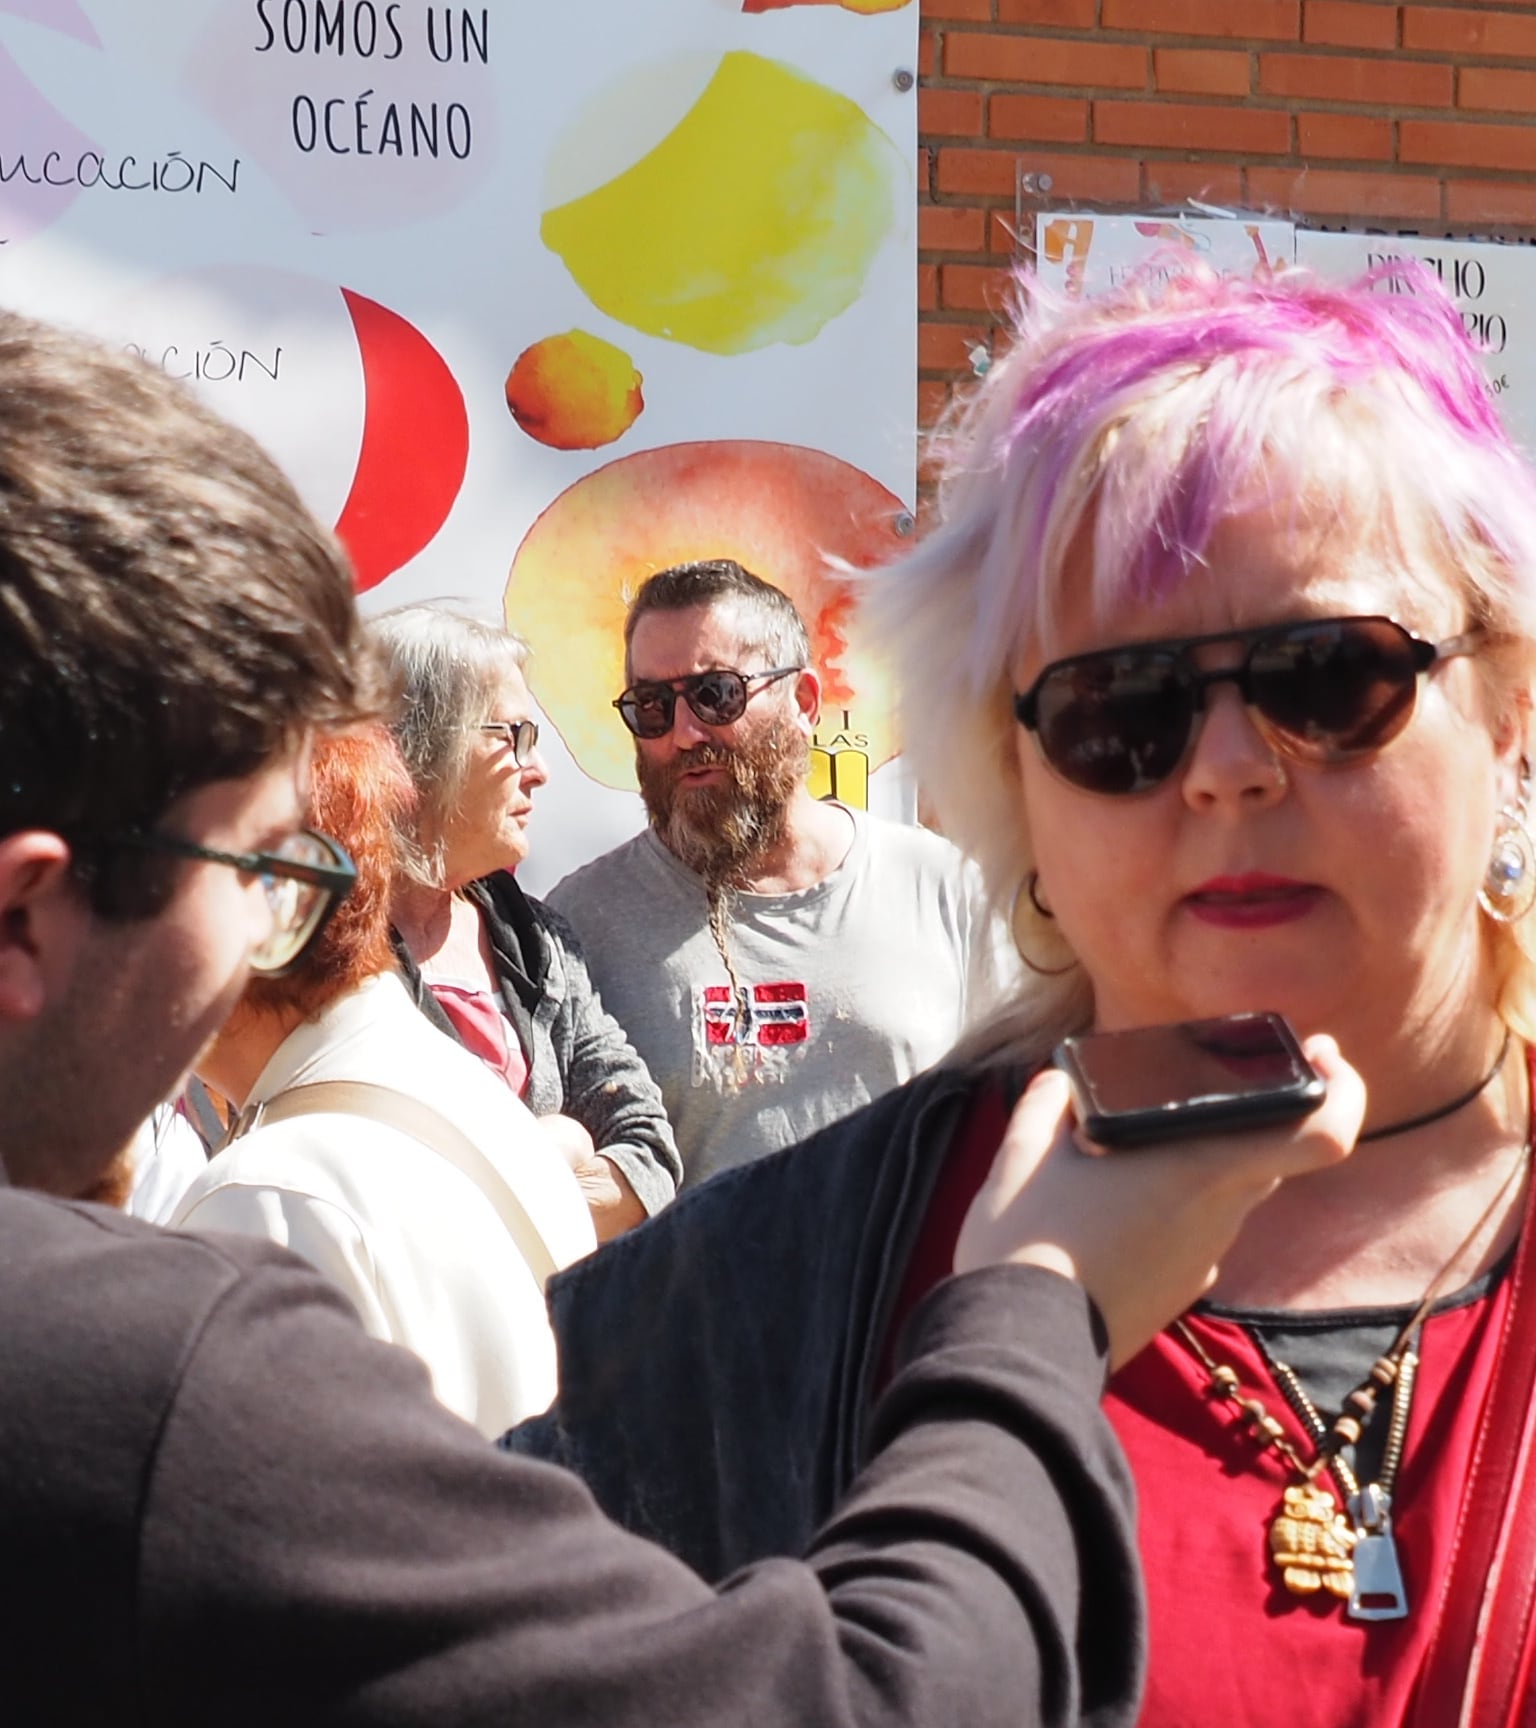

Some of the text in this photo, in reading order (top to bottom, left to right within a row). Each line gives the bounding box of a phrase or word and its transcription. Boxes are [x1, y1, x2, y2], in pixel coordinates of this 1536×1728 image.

[255, 0, 488, 64] SOMOS UN
[292, 89, 472, 160] OCÉANO
